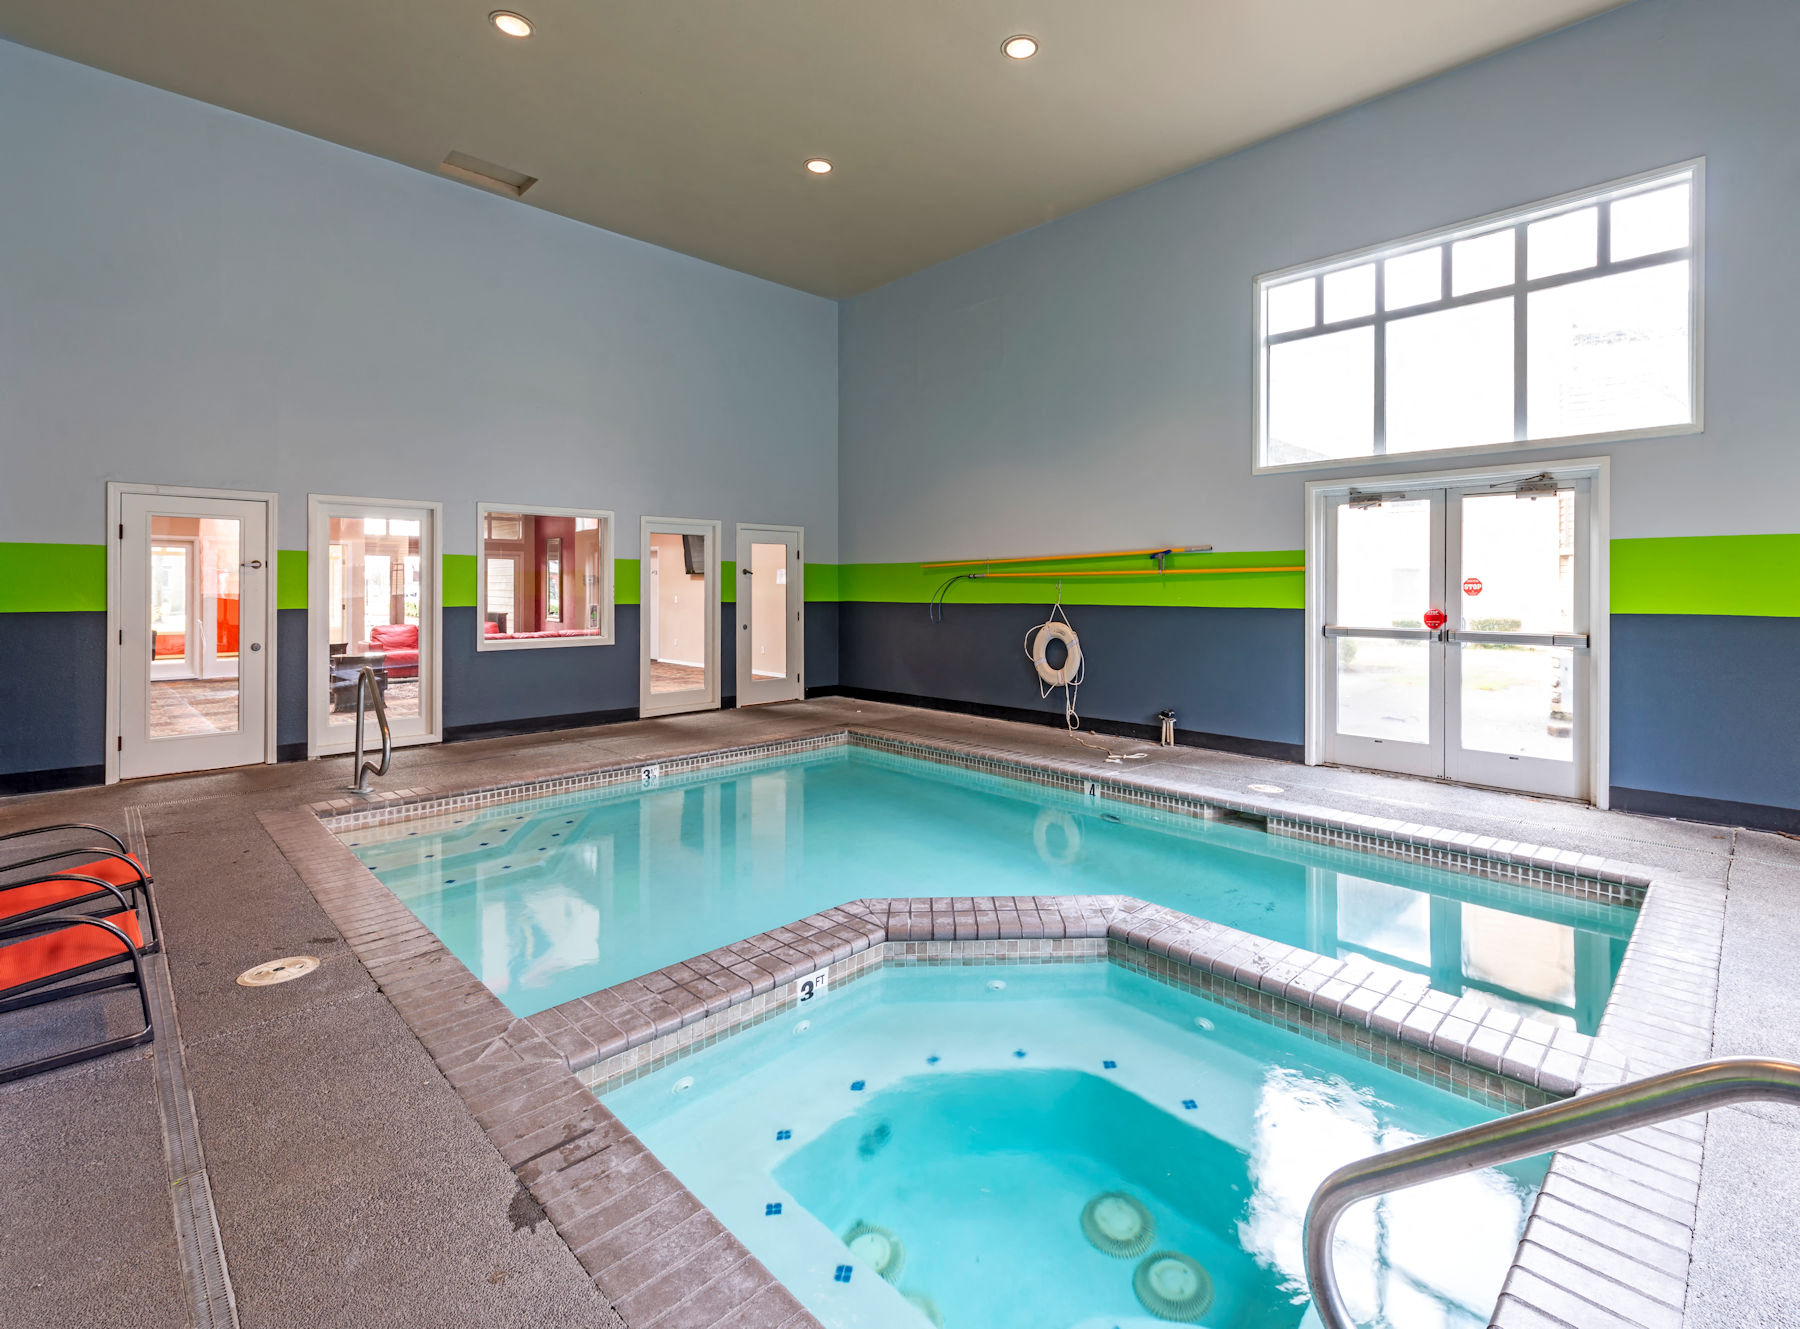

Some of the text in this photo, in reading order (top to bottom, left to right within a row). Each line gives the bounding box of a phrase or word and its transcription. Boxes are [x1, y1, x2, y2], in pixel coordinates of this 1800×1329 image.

[643, 769, 651, 779] 3
[1089, 783, 1096, 796] 4
[800, 974, 825, 1001] 3 FT
